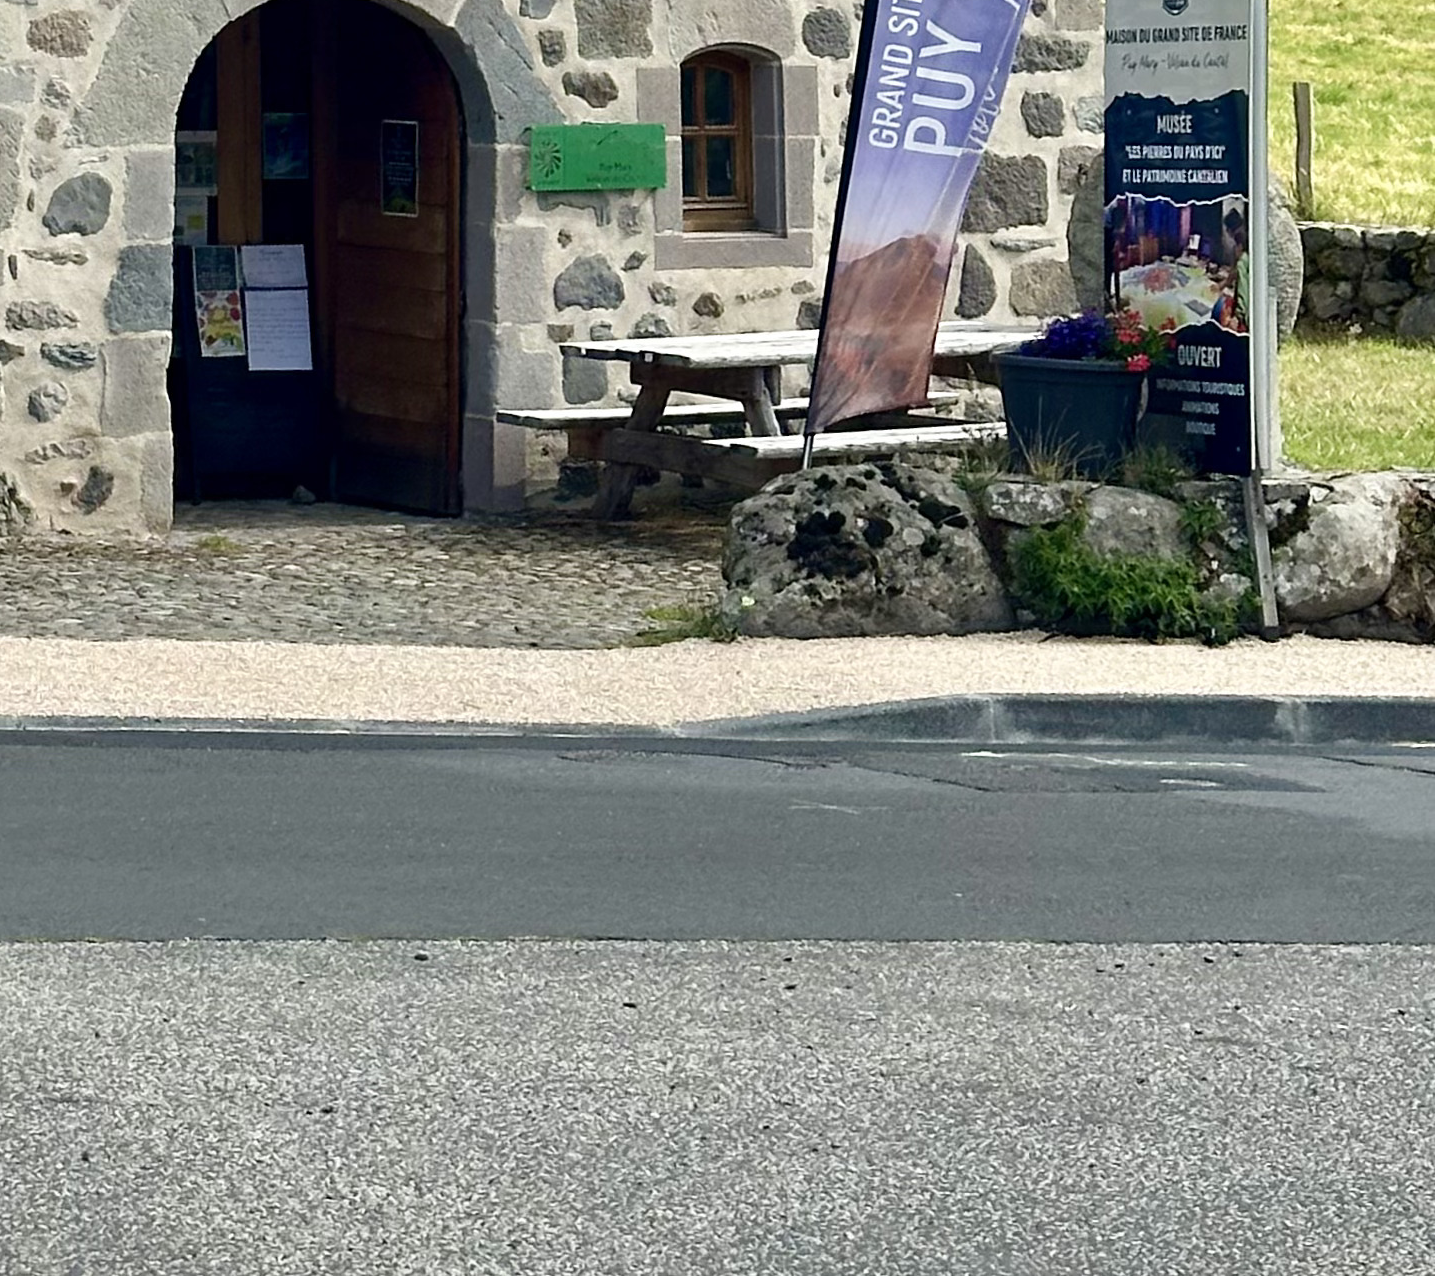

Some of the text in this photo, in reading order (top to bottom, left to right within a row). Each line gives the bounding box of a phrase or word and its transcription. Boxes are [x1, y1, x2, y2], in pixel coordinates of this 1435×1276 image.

[1106, 24, 1248, 44] MAISON DU GRAND SITE DE FRANCE
[868, 43, 914, 149] GRAND
[903, 19, 982, 157] PUY
[1157, 110, 1193, 134] MUSÉE
[1142, 145, 1172, 159] PIERRES
[1174, 145, 1184, 159] DU
[1185, 145, 1205, 159] PAYS
[1122, 169, 1132, 183] ET
[1132, 169, 1141, 183] LE
[1142, 169, 1187, 183] PATRIMOINE
[1177, 344, 1222, 369] OUVERT
